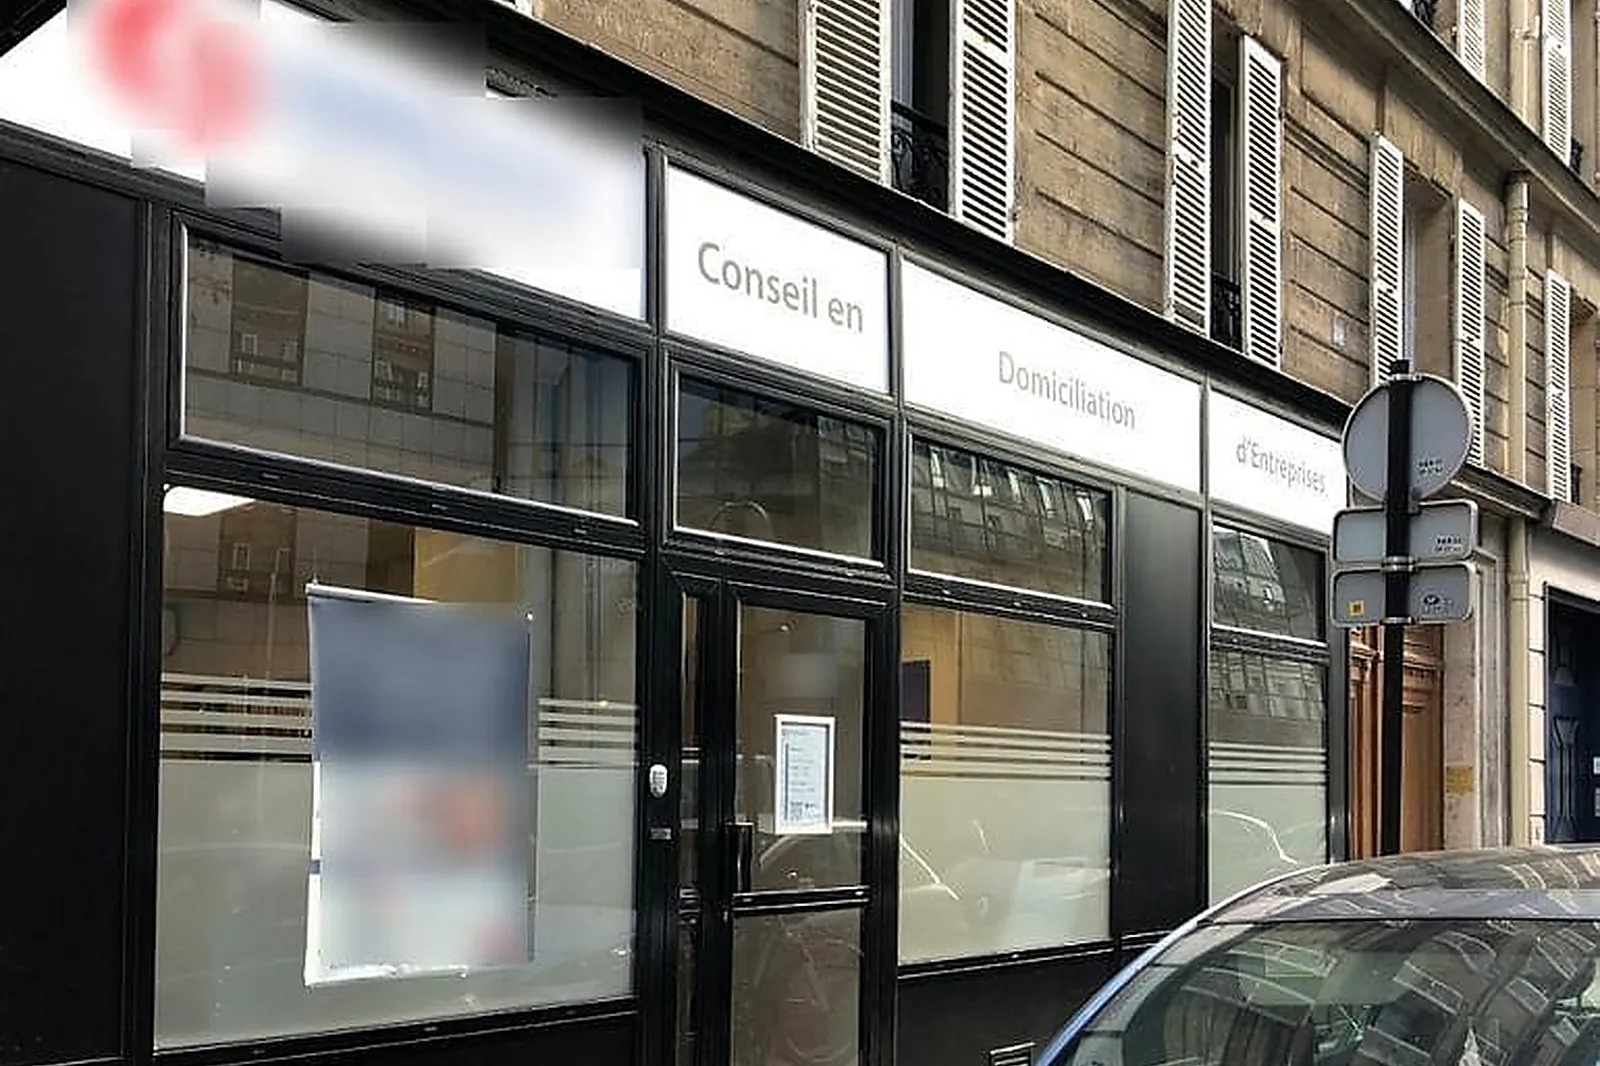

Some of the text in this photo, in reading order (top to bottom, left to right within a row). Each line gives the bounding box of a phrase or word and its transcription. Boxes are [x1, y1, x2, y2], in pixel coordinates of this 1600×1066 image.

[698, 242, 864, 333] Conseil en
[998, 350, 1136, 430] Domiciliation
[1236, 437, 1325, 494] d'Entreprises
